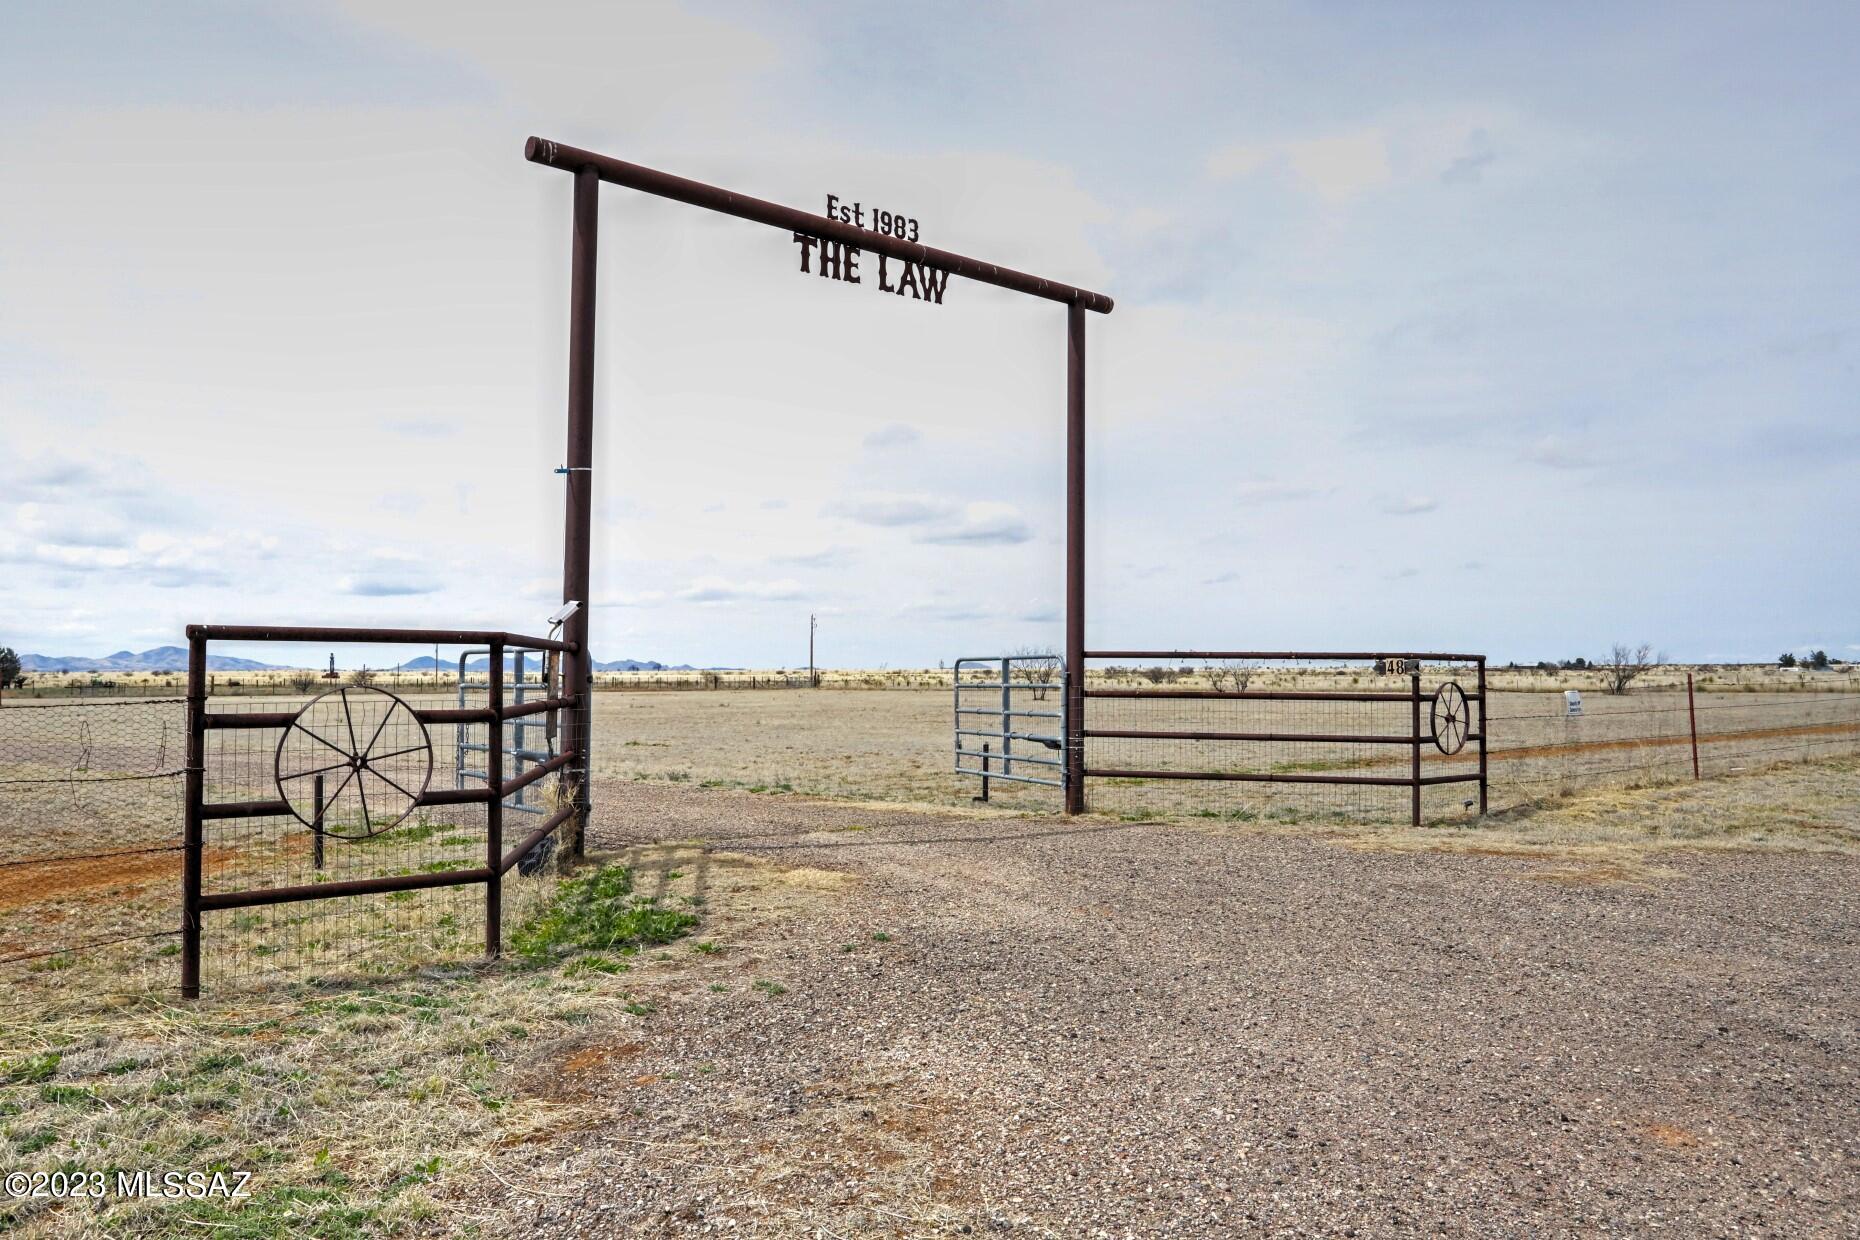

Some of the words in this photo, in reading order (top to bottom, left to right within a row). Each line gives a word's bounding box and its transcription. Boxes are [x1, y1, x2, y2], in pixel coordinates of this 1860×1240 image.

[826, 194, 865, 228] Est
[872, 208, 919, 243] 1983
[793, 232, 861, 284] THE
[877, 254, 950, 305] LAW
[1387, 659, 1405, 675] 48
